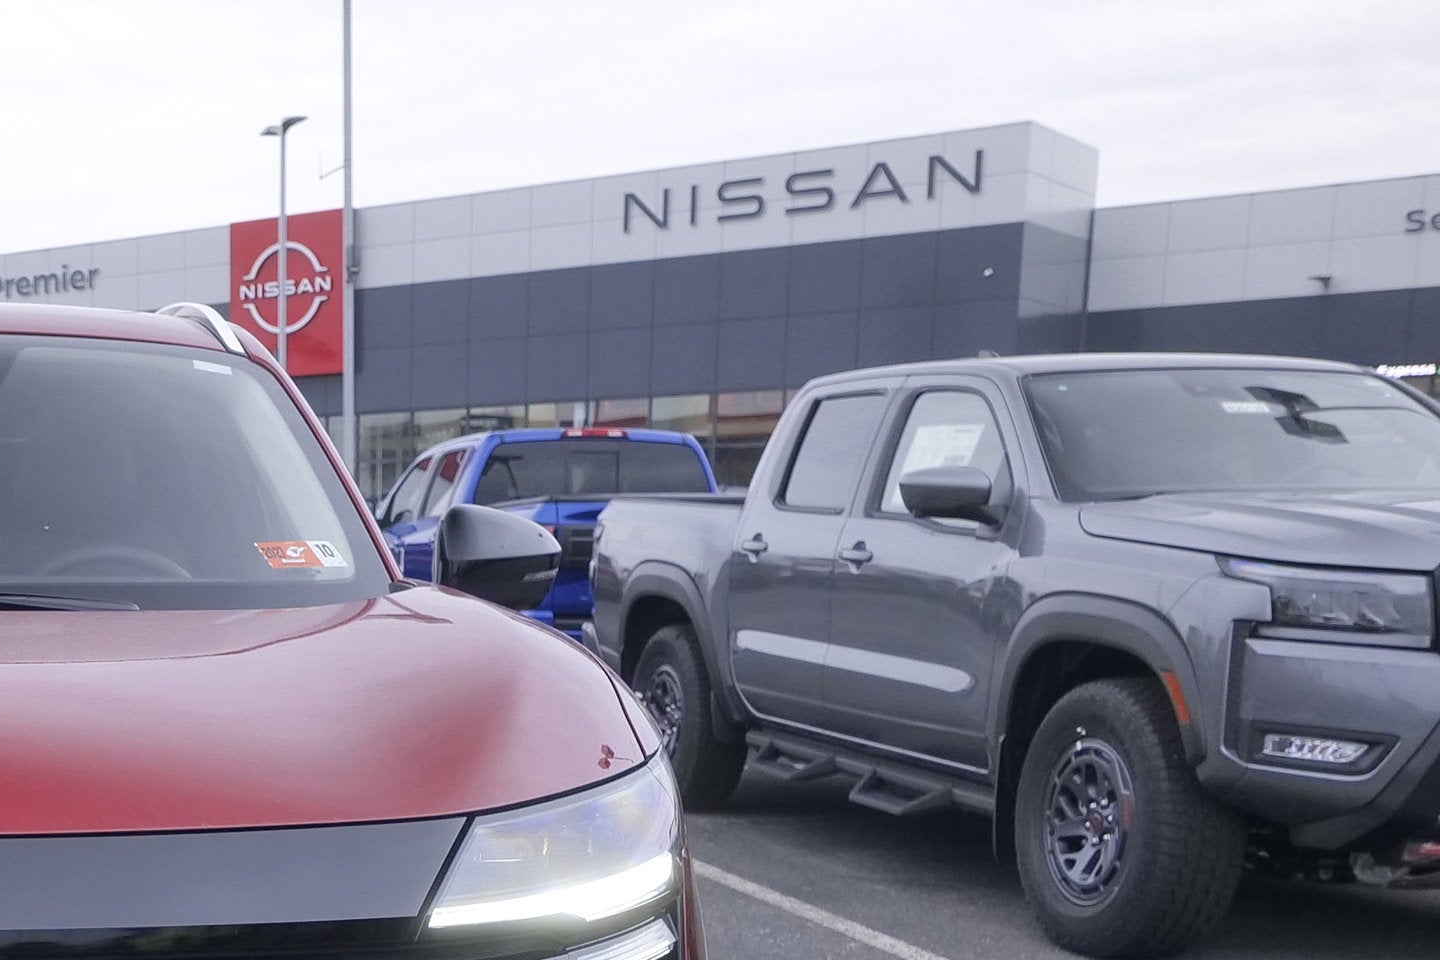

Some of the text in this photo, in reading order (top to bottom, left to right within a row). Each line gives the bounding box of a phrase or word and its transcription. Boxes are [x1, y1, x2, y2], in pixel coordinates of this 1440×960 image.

[623, 149, 984, 233] NISSAN
[239, 275, 332, 301] NISSAN
[315, 544, 336, 559] 10
